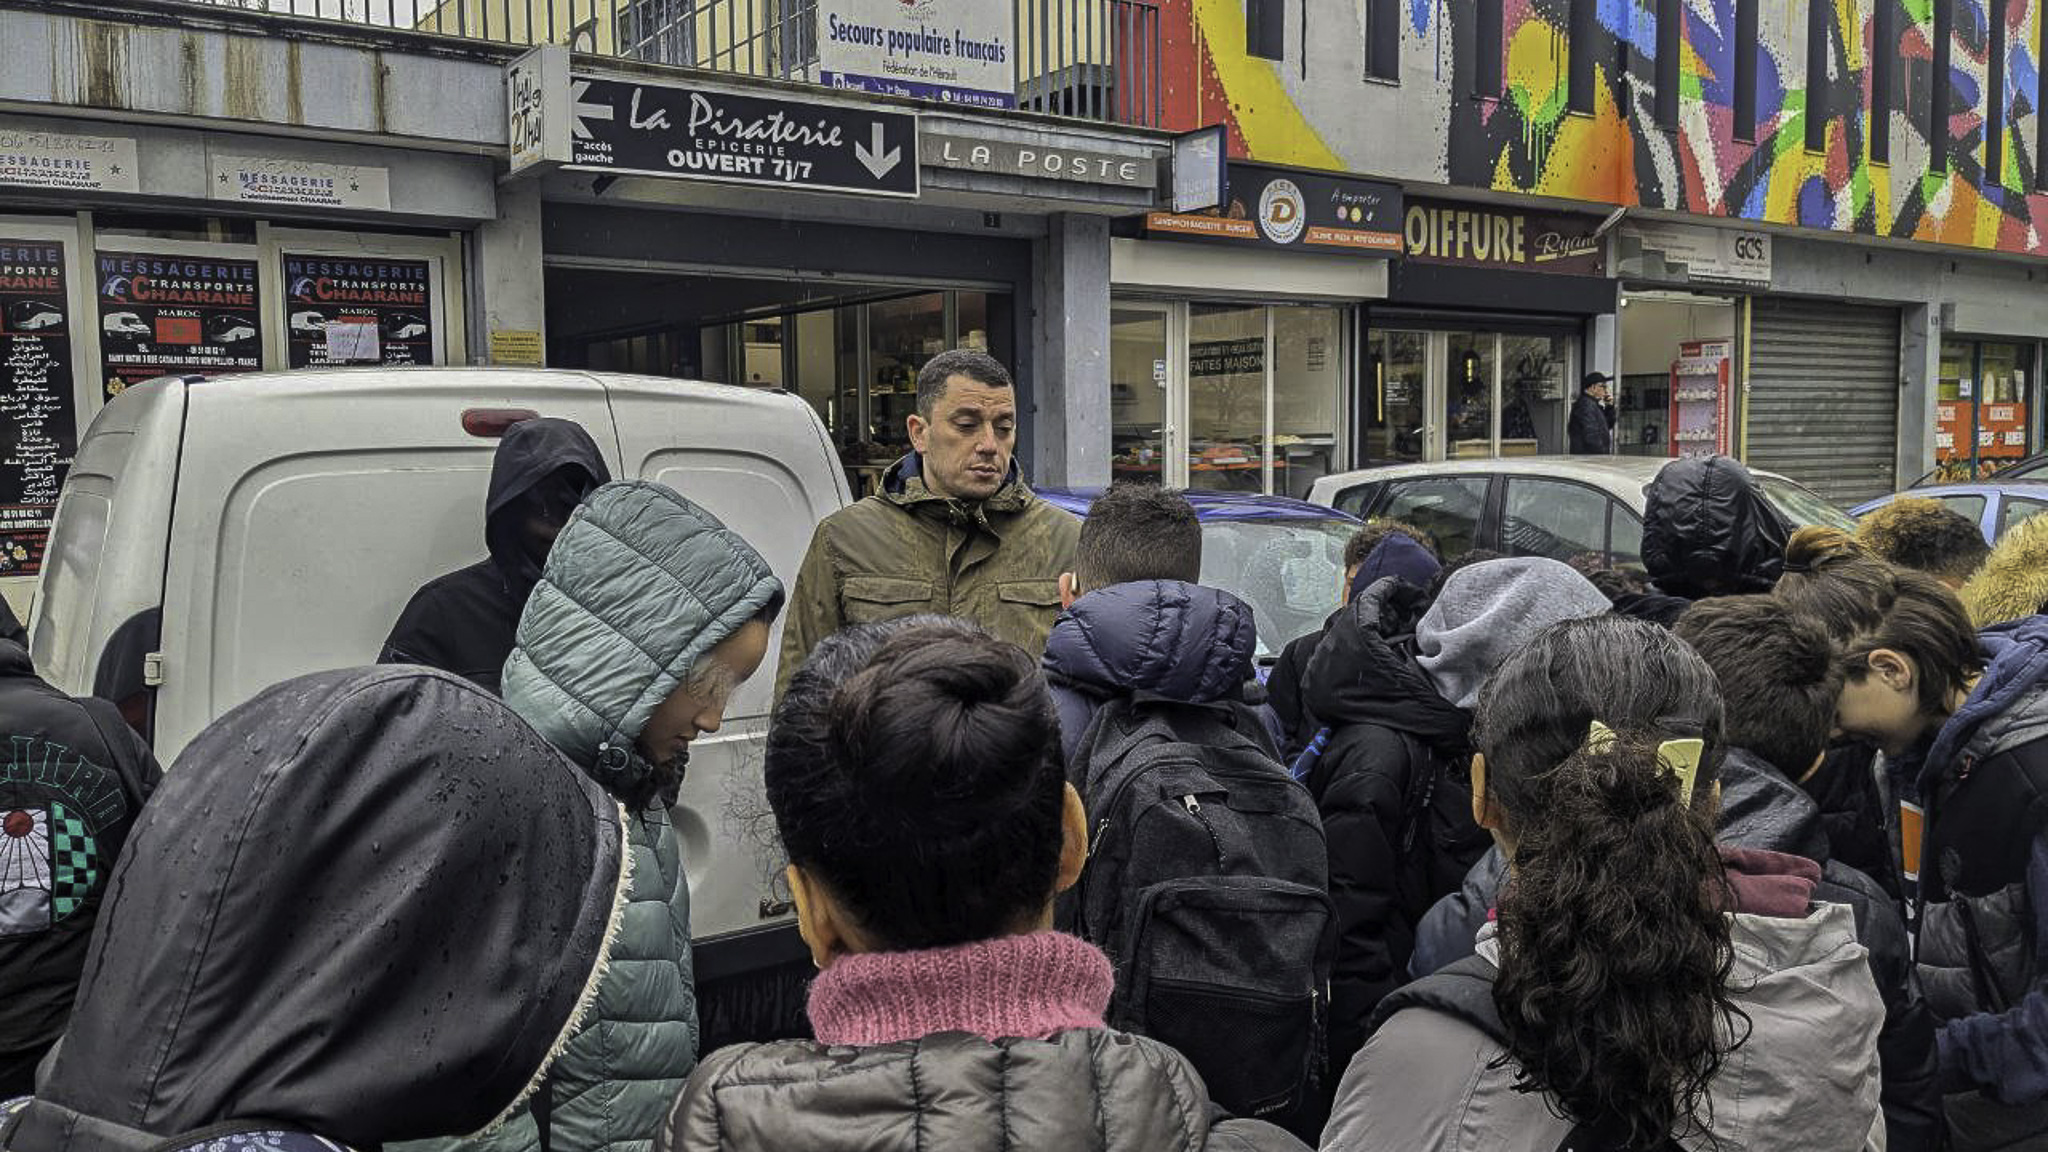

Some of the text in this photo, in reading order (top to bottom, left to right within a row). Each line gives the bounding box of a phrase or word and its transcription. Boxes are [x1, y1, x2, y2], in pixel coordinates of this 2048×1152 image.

[829, 13, 883, 47] Secours
[888, 25, 950, 58] populaire
[955, 30, 1006, 67] français
[630, 87, 843, 146] La Piraterie
[695, 138, 786, 157] EPICERIE
[575, 153, 614, 163] gauche
[667, 149, 813, 182] OUVERT 7j/7
[943, 142, 1139, 181] LA POSTE
[240, 172, 334, 188] MESSAGERIE
[1735, 236, 1763, 260] GCS
[101, 259, 254, 280] MESSAGERIE
[289, 262, 424, 279] MESSAGERIE
[131, 275, 254, 305] CHAARANE
[150, 279, 254, 292] TRANSPORTS
[316, 276, 425, 303] CHAARANE
[332, 280, 426, 292] TRANSPORTS
[157, 309, 201, 317] MAROC
[339, 308, 379, 316] MAROC
